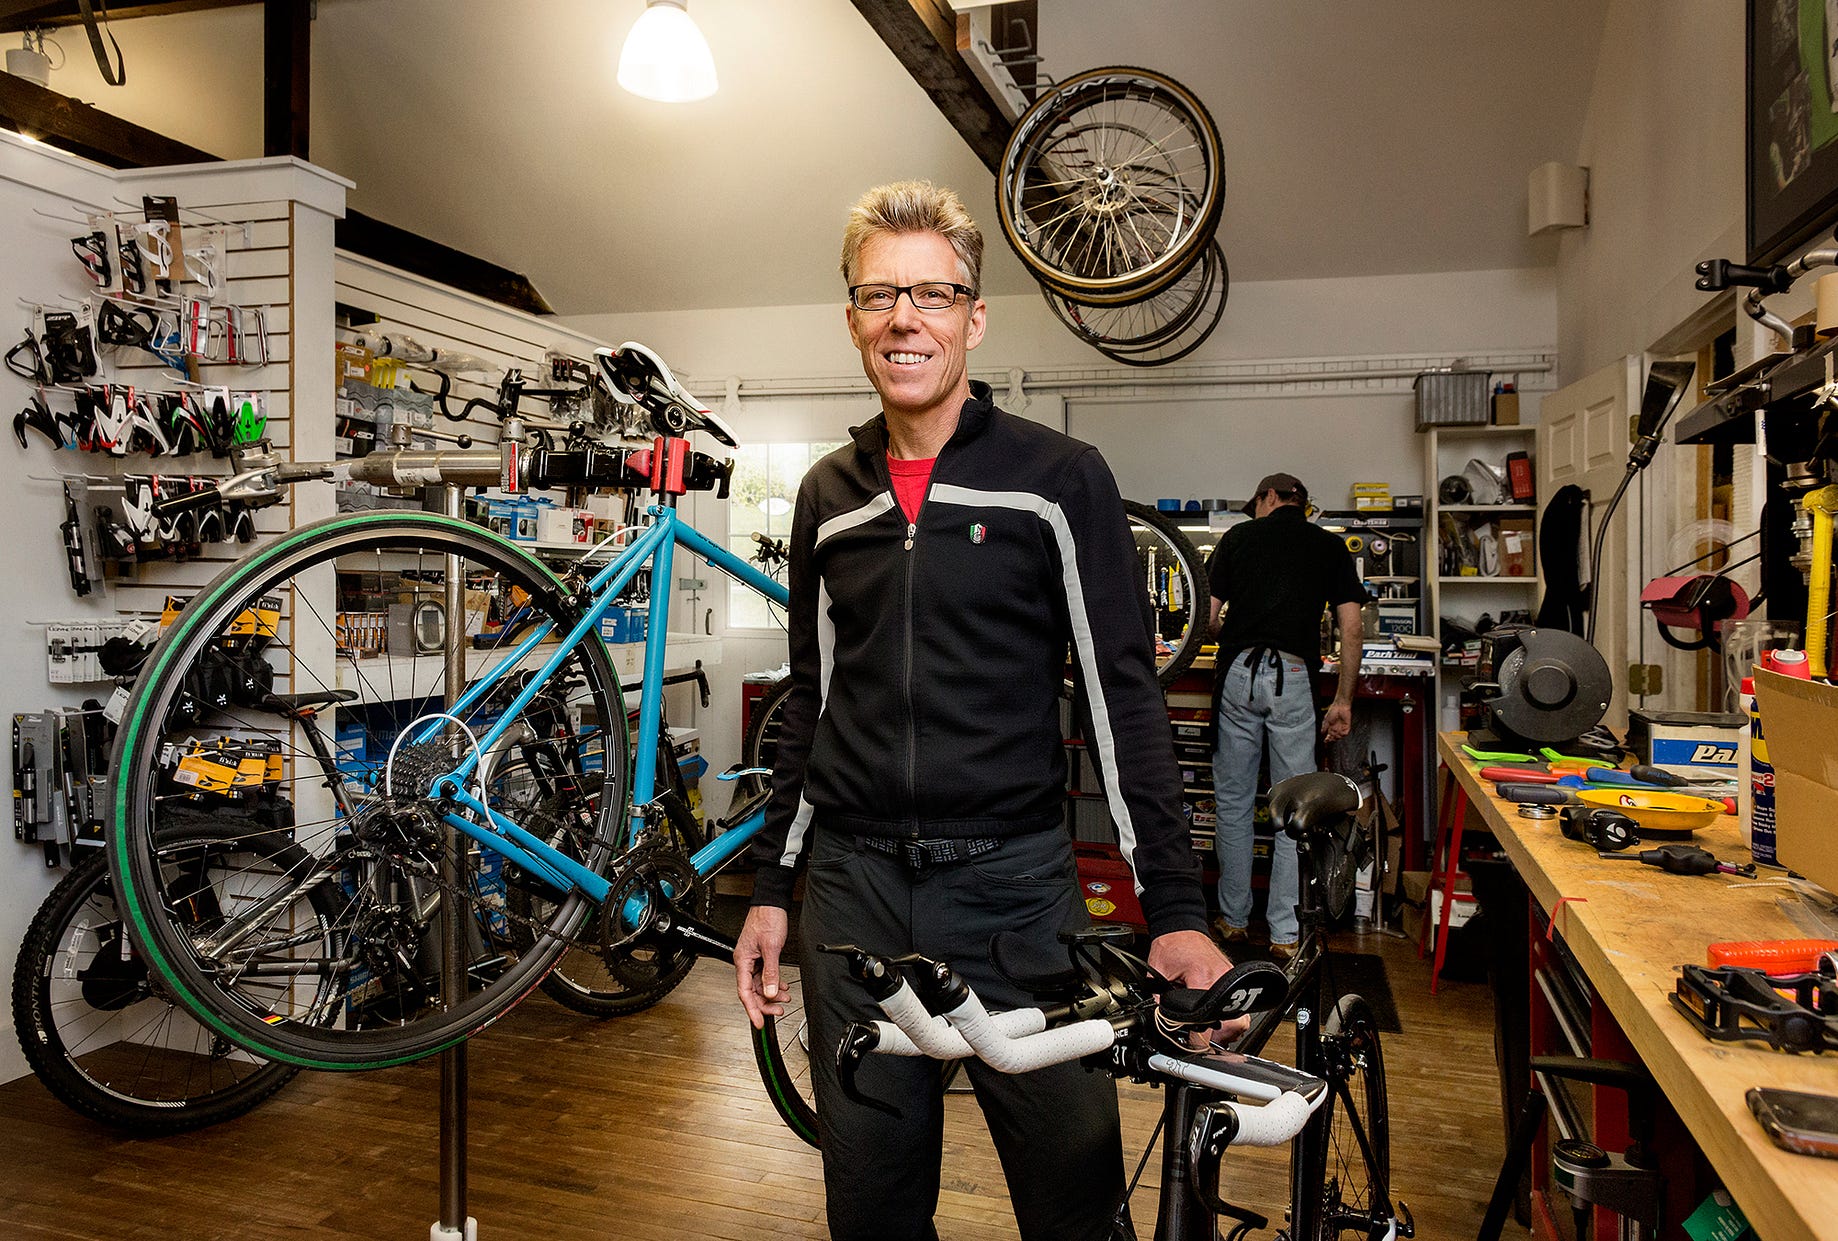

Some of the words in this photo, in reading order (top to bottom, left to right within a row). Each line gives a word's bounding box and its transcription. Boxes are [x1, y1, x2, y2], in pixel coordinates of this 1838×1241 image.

[1223, 987, 1264, 1012] 3T
[1114, 1028, 1129, 1039] NCE
[1112, 1044, 1128, 1067] 3T
